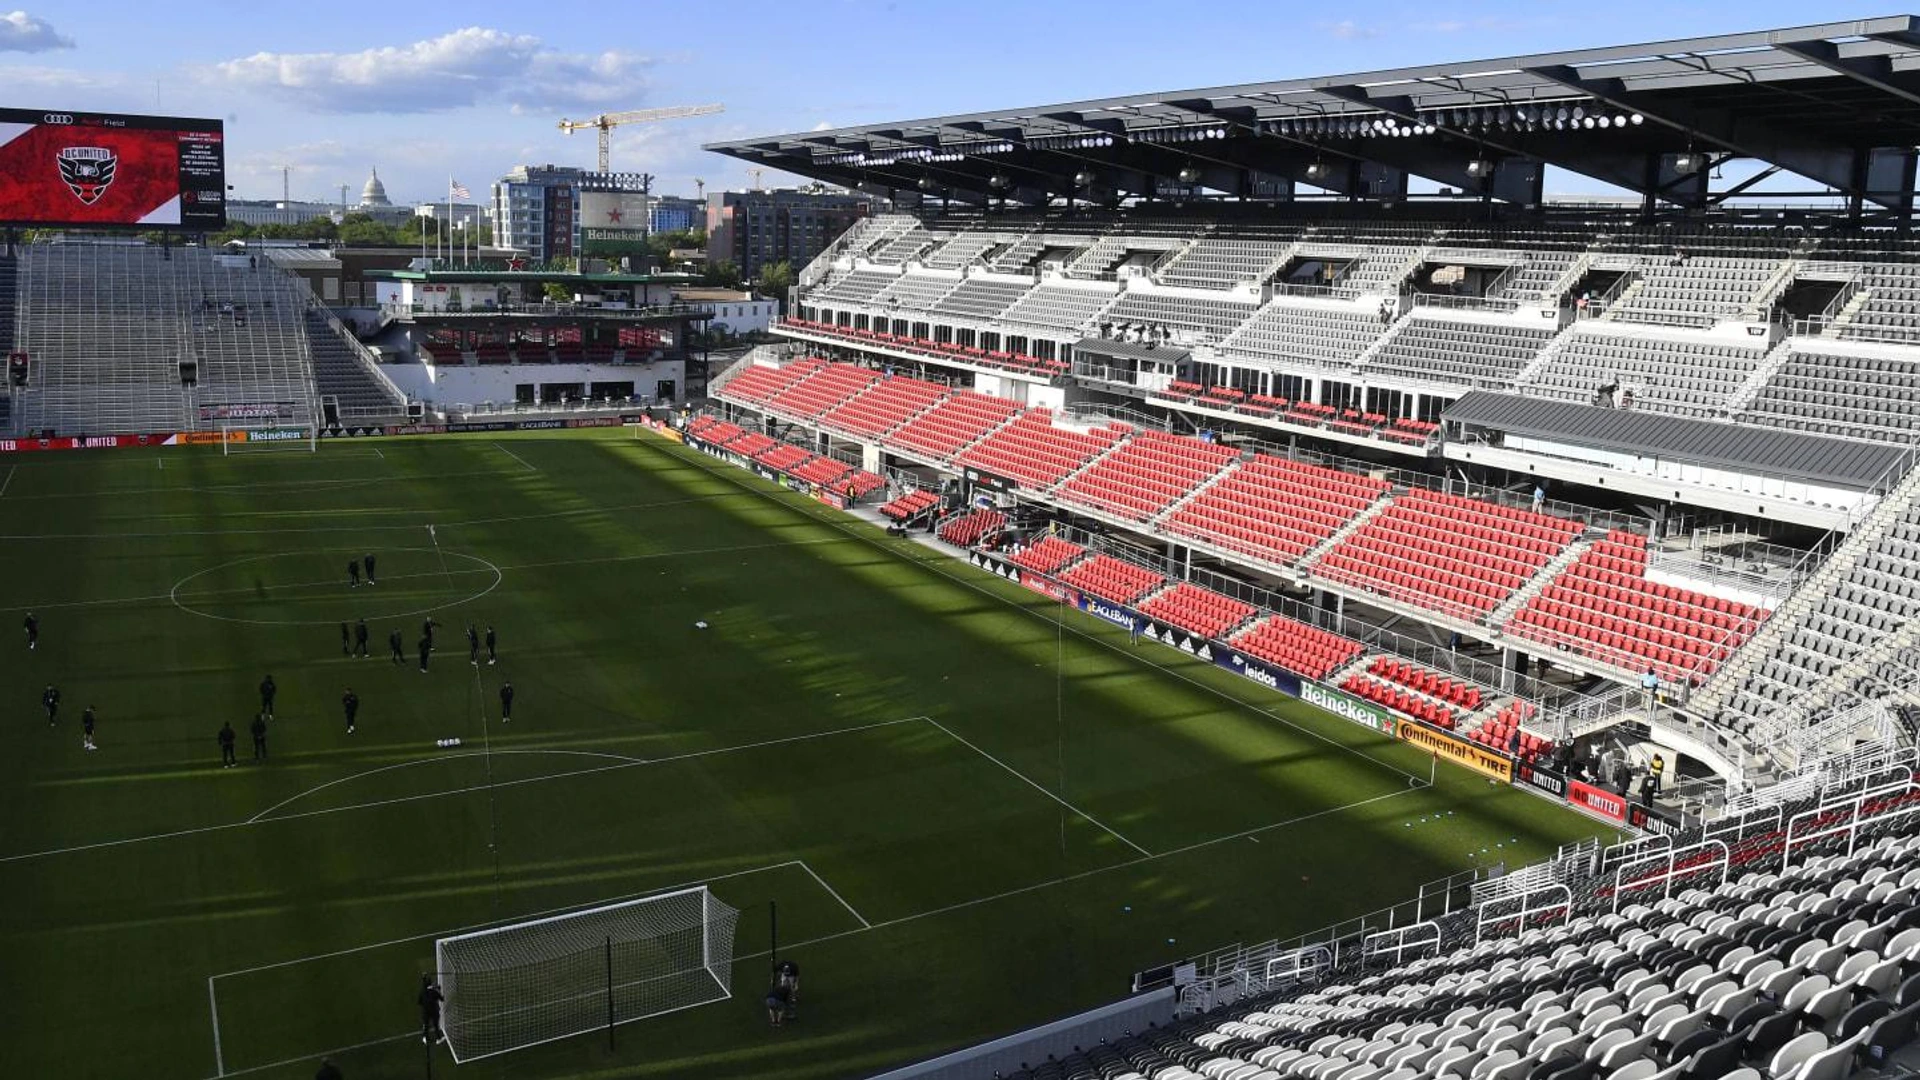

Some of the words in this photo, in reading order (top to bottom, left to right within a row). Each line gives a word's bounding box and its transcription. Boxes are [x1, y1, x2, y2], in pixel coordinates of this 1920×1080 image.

[78, 148, 108, 160] UNITED
[587, 229, 643, 241] Heineken
[86, 437, 118, 448] UNITED
[250, 429, 301, 441] Heineken
[1091, 600, 1135, 629] EAGLEBAN
[1245, 662, 1278, 687] leidos
[1301, 681, 1379, 728] Heineken
[1402, 723, 1466, 759] Continental
[1479, 755, 1508, 774] TIRE
[1533, 771, 1562, 793] UNITED
[1587, 793, 1620, 816] UNITED
